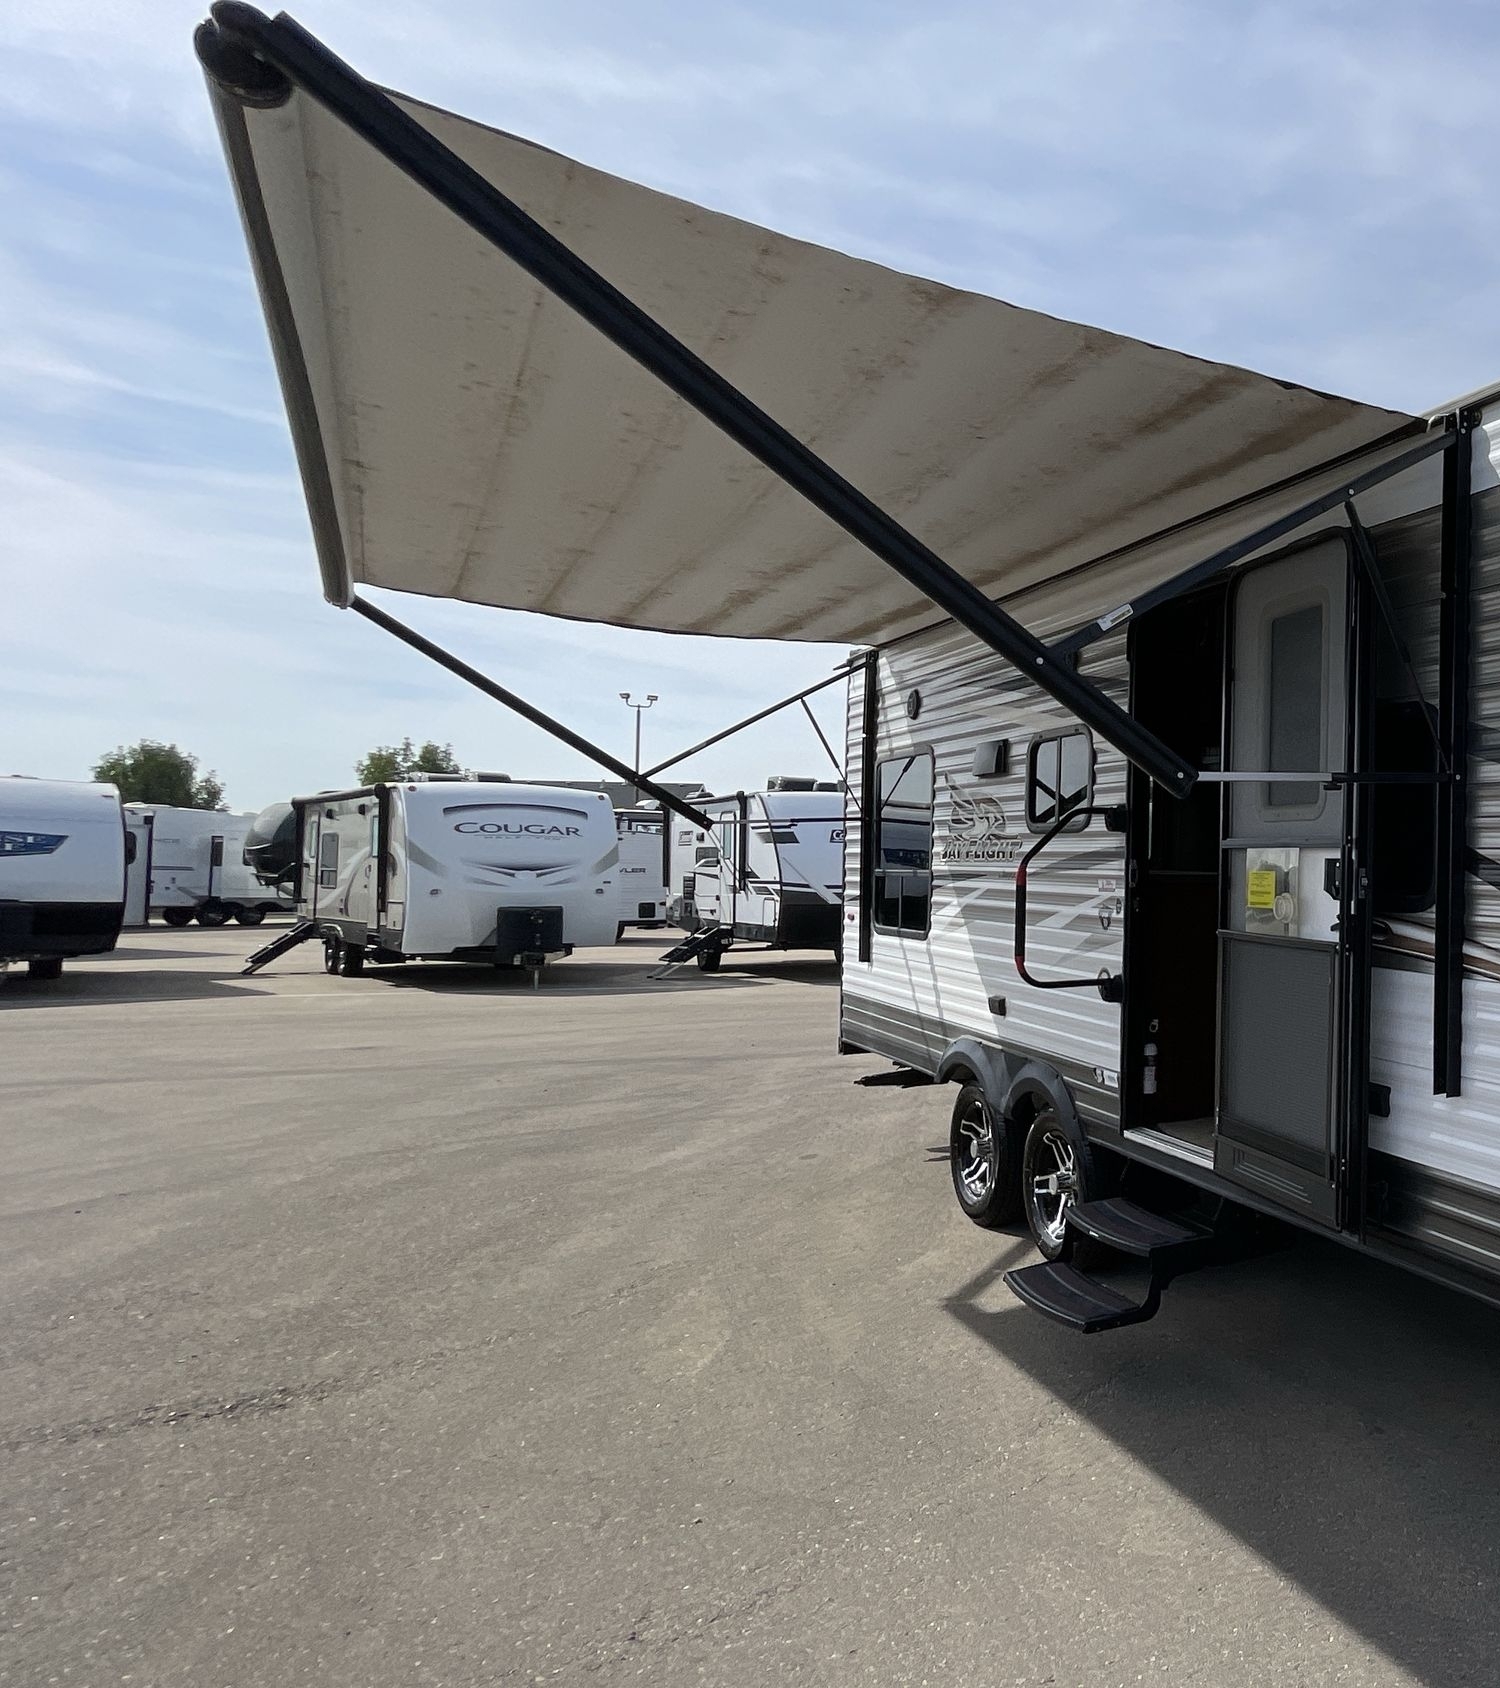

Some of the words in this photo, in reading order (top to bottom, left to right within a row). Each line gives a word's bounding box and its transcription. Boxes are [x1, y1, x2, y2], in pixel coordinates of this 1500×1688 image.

[454, 822, 583, 837] COUGAR
[941, 840, 968, 861] JAY
[964, 839, 1022, 861] FLIGHT
